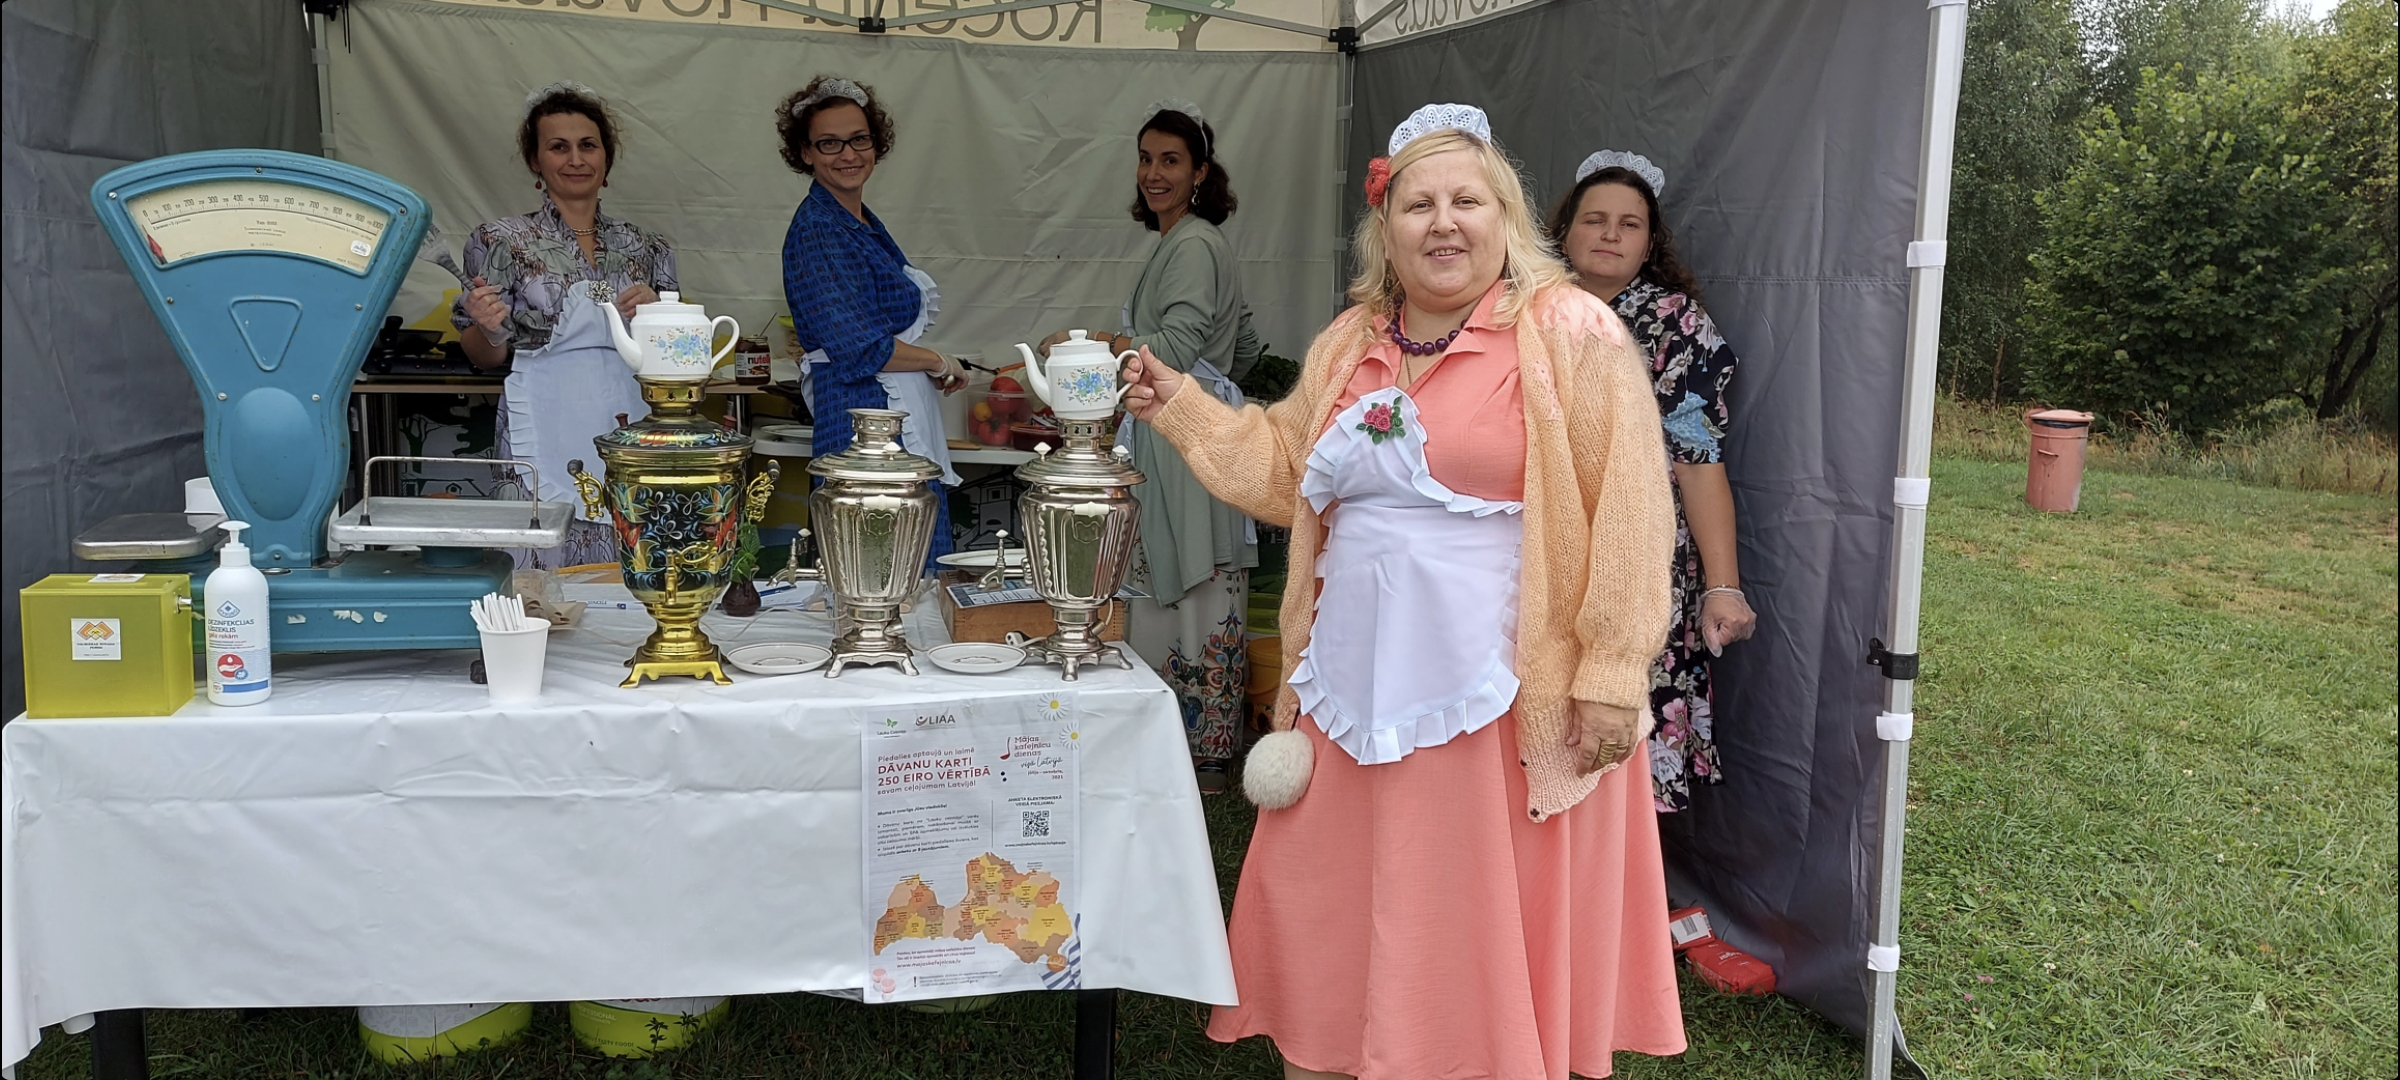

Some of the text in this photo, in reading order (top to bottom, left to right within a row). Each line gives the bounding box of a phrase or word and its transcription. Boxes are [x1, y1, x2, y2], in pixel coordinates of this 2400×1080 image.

[142, 210, 148, 218] 0
[162, 203, 172, 212] 100
[183, 198, 195, 207] 200
[207, 196, 218, 204] 300
[233, 194, 243, 202] 400
[259, 194, 269, 202] 500
[284, 197, 294, 205] 600
[309, 200, 320, 209] 700
[332, 206, 343, 215] 800
[355, 213, 366, 222] 900
[372, 220, 384, 230] 1000
[747, 354, 771, 364] nutell
[929, 715, 955, 725] LIAA
[878, 753, 911, 762] Piedalies
[912, 749, 941, 759] aptaujā
[878, 757, 972, 774] DĀVANU KARTI
[878, 766, 991, 787] 250 EIRO VĒRTĪBĀ
[878, 780, 976, 795] savam ceļojumam Latvijā!
